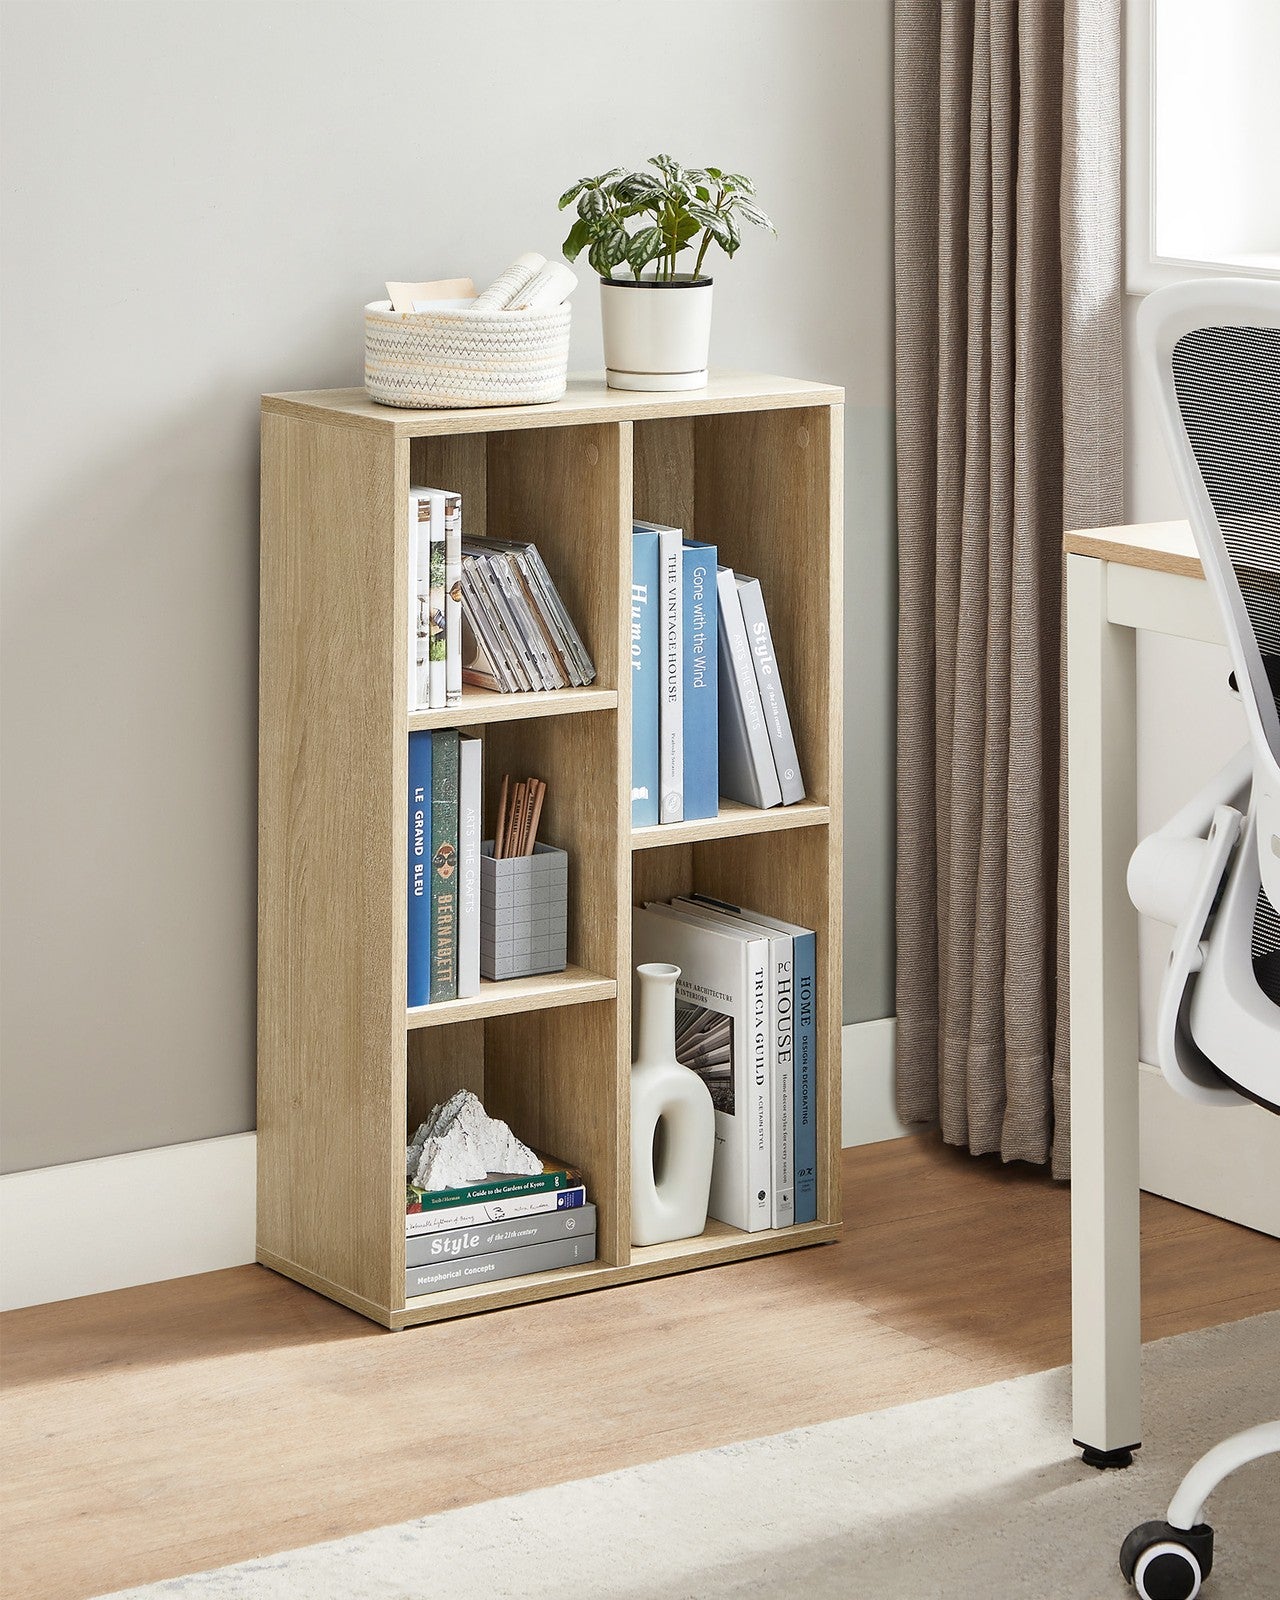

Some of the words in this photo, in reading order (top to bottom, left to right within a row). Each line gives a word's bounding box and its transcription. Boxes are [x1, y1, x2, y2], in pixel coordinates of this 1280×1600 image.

[668, 554, 677, 584] THE
[693, 567, 707, 600] Gone
[632, 584, 648, 671] Humor
[668, 587, 677, 651] VINTAGE
[693, 603, 707, 631] with
[693, 632, 707, 654] the
[734, 634, 746, 661] ARTS
[668, 653, 677, 702] HOUSE
[693, 656, 707, 688] Wind
[740, 664, 752, 686] THE
[753, 622, 773, 675] Style
[773, 716, 784, 739] century
[745, 690, 761, 730] CRAFTS
[414, 787, 424, 802] LE
[414, 810, 424, 856] GRAND
[466, 807, 475, 836] ARTS
[466, 843, 475, 864] THE
[414, 864, 424, 896] BLEU
[465, 870, 475, 913] CRAFTS
[778, 961, 791, 973] PC
[680, 988, 708, 1003] INTERIORS
[693, 984, 734, 1002] ARCHITECTURE
[755, 967, 764, 1028] TRICIA
[800, 976, 811, 1026] HOME
[778, 979, 791, 1064] HOUSE
[755, 1033, 764, 1085] GUILD
[472, 1189, 487, 1198] Guide
[494, 1186, 502, 1194] the
[502, 1183, 524, 1193] Gardens
[523, 1182, 530, 1190] of
[530, 1180, 545, 1190] Kyoto
[431, 1233, 480, 1255] Style
[487, 1234, 496, 1243] of
[495, 1232, 504, 1240] the
[517, 1227, 538, 1237] century
[417, 1269, 462, 1285] Metaphorical
[464, 1263, 496, 1276] Concepts
